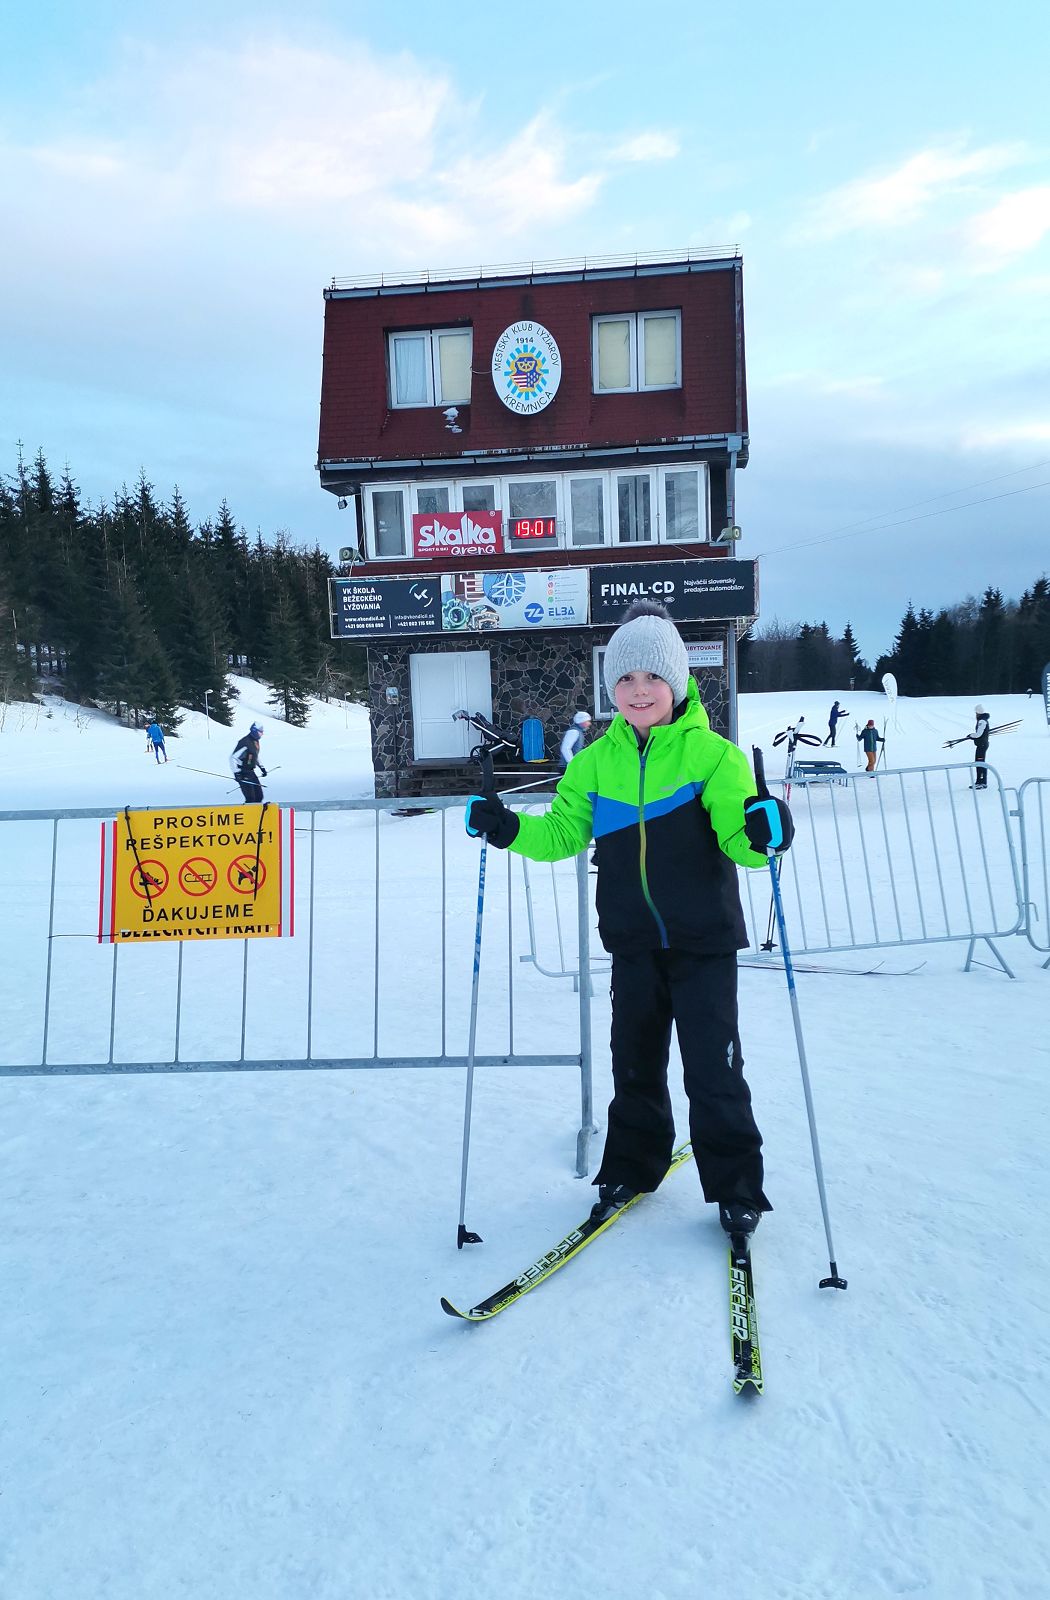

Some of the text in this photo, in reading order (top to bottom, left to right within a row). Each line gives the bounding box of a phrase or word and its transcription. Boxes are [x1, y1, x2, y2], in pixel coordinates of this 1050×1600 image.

[511, 322, 533, 335] KLUB
[503, 391, 553, 413] KREMNICA
[418, 513, 496, 547] Skalka
[451, 544, 496, 555] arena
[708, 577, 736, 585] slovenský
[353, 586, 375, 594] ŠKOLA
[683, 584, 745, 594] predajca automobilov
[342, 594, 382, 603] BEŽECKÉHO
[548, 606, 575, 616] ELBA
[153, 811, 245, 830] PROSÍME
[142, 903, 254, 923] ĎAKUJEME
[516, 1230, 584, 1287] FISCHER
[731, 1267, 749, 1342] FISCHER
